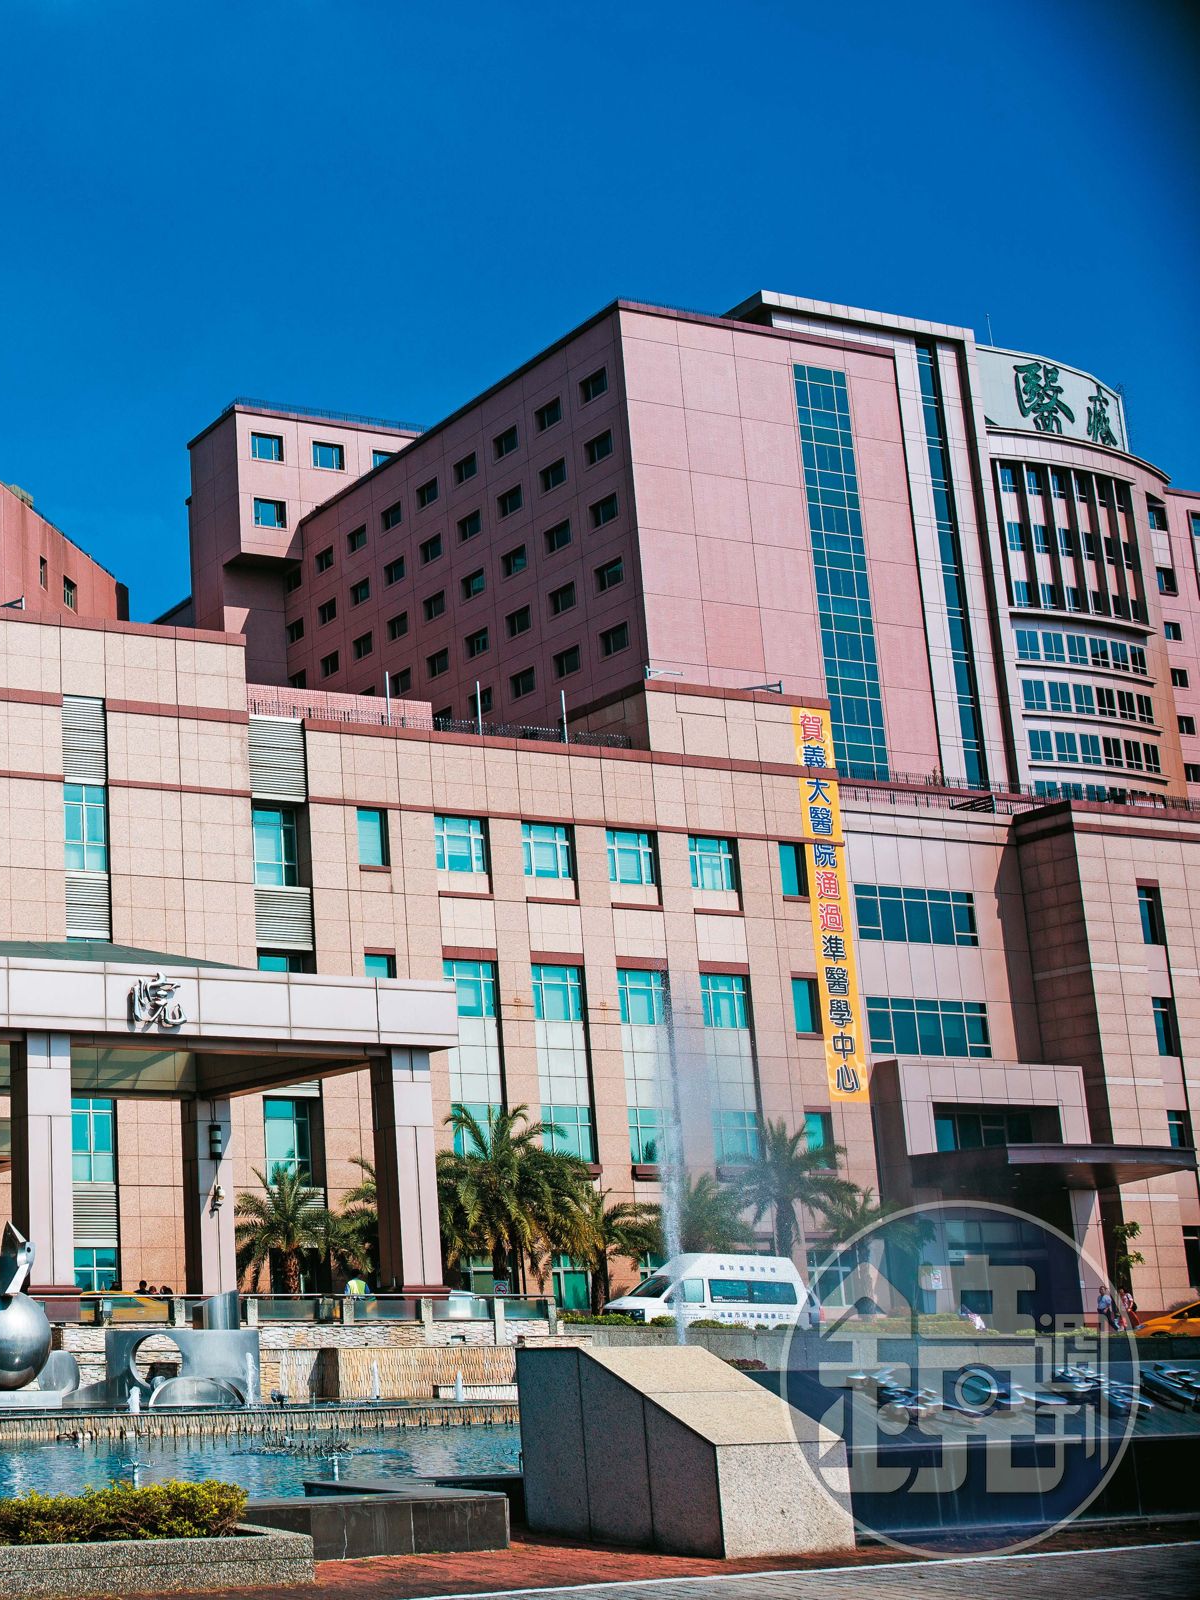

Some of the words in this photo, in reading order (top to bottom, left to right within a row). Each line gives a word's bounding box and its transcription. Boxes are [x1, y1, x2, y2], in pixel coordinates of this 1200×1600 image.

[800, 714, 860, 1092] 賀義大醫院通過準醫學中心
